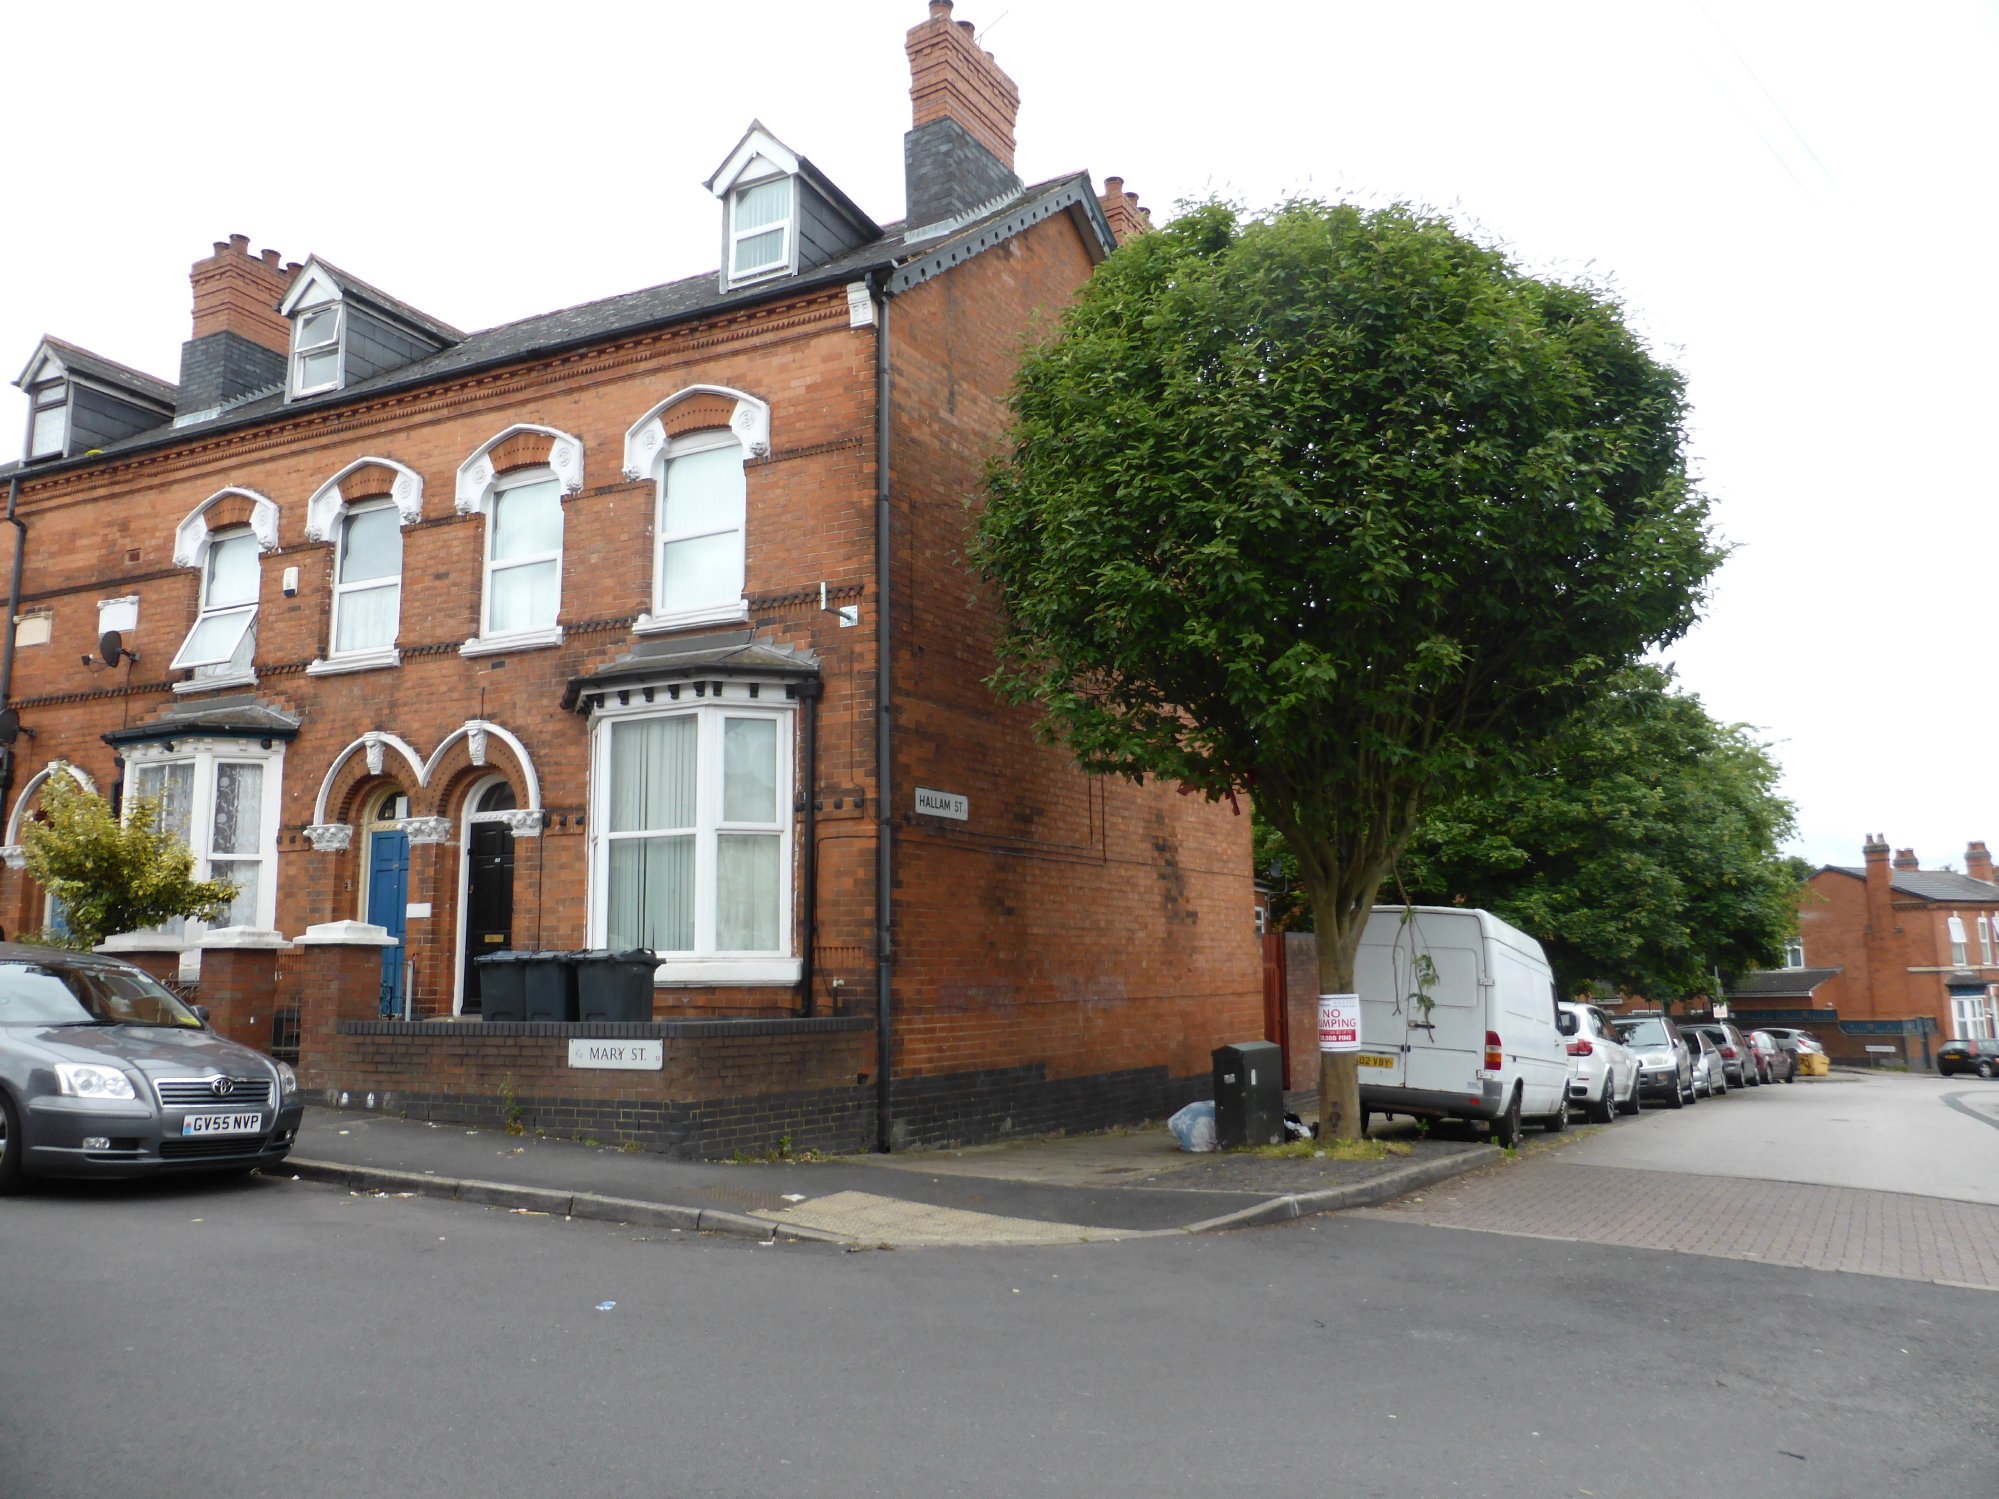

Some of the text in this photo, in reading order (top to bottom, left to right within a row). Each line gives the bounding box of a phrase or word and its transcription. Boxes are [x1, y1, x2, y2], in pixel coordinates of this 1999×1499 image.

[920, 794, 963, 813] HALLAM ST
[1323, 1008, 1341, 1018] NO
[589, 1047, 626, 1061] MARY
[631, 1047, 647, 1061] ST.
[193, 1115, 260, 1131] GV55 NVP
